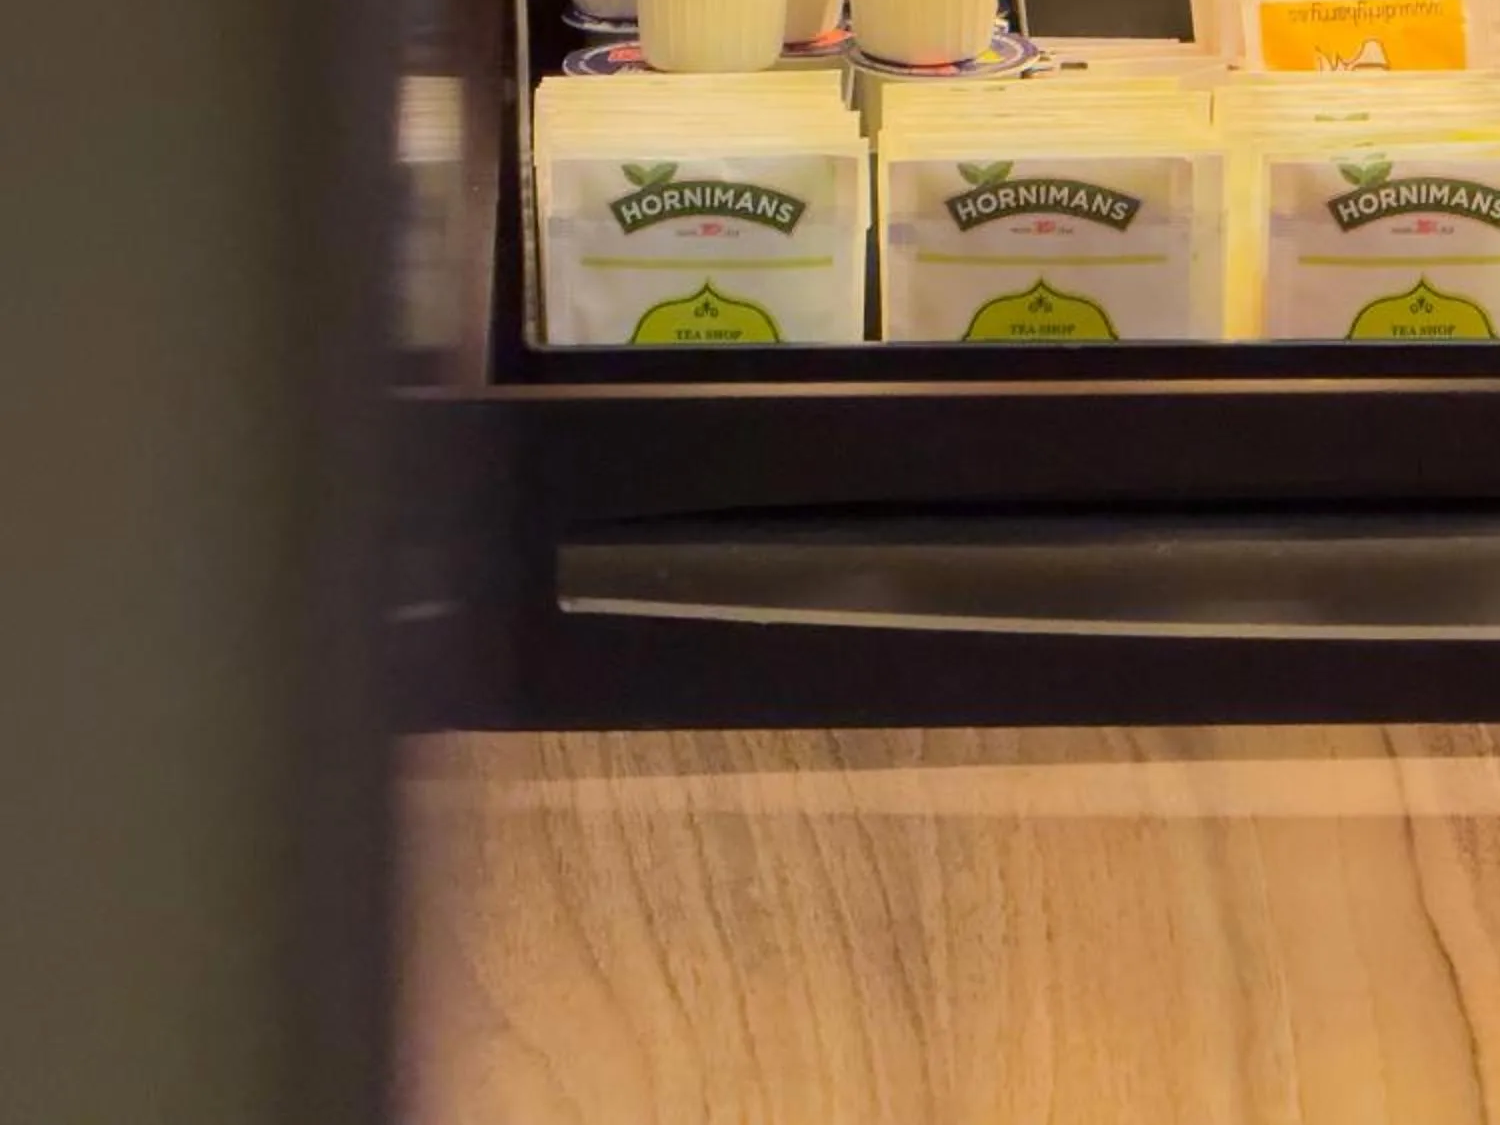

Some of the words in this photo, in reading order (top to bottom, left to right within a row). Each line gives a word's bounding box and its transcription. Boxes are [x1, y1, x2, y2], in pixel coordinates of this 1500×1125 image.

[620, 186, 795, 224] HORNIMANS
[956, 184, 1129, 222] HORNIMANS
[675, 329, 700, 340] TEA
[705, 329, 743, 340] SHOP
[1010, 324, 1035, 335] TEA
[1392, 325, 1417, 336] TEA
